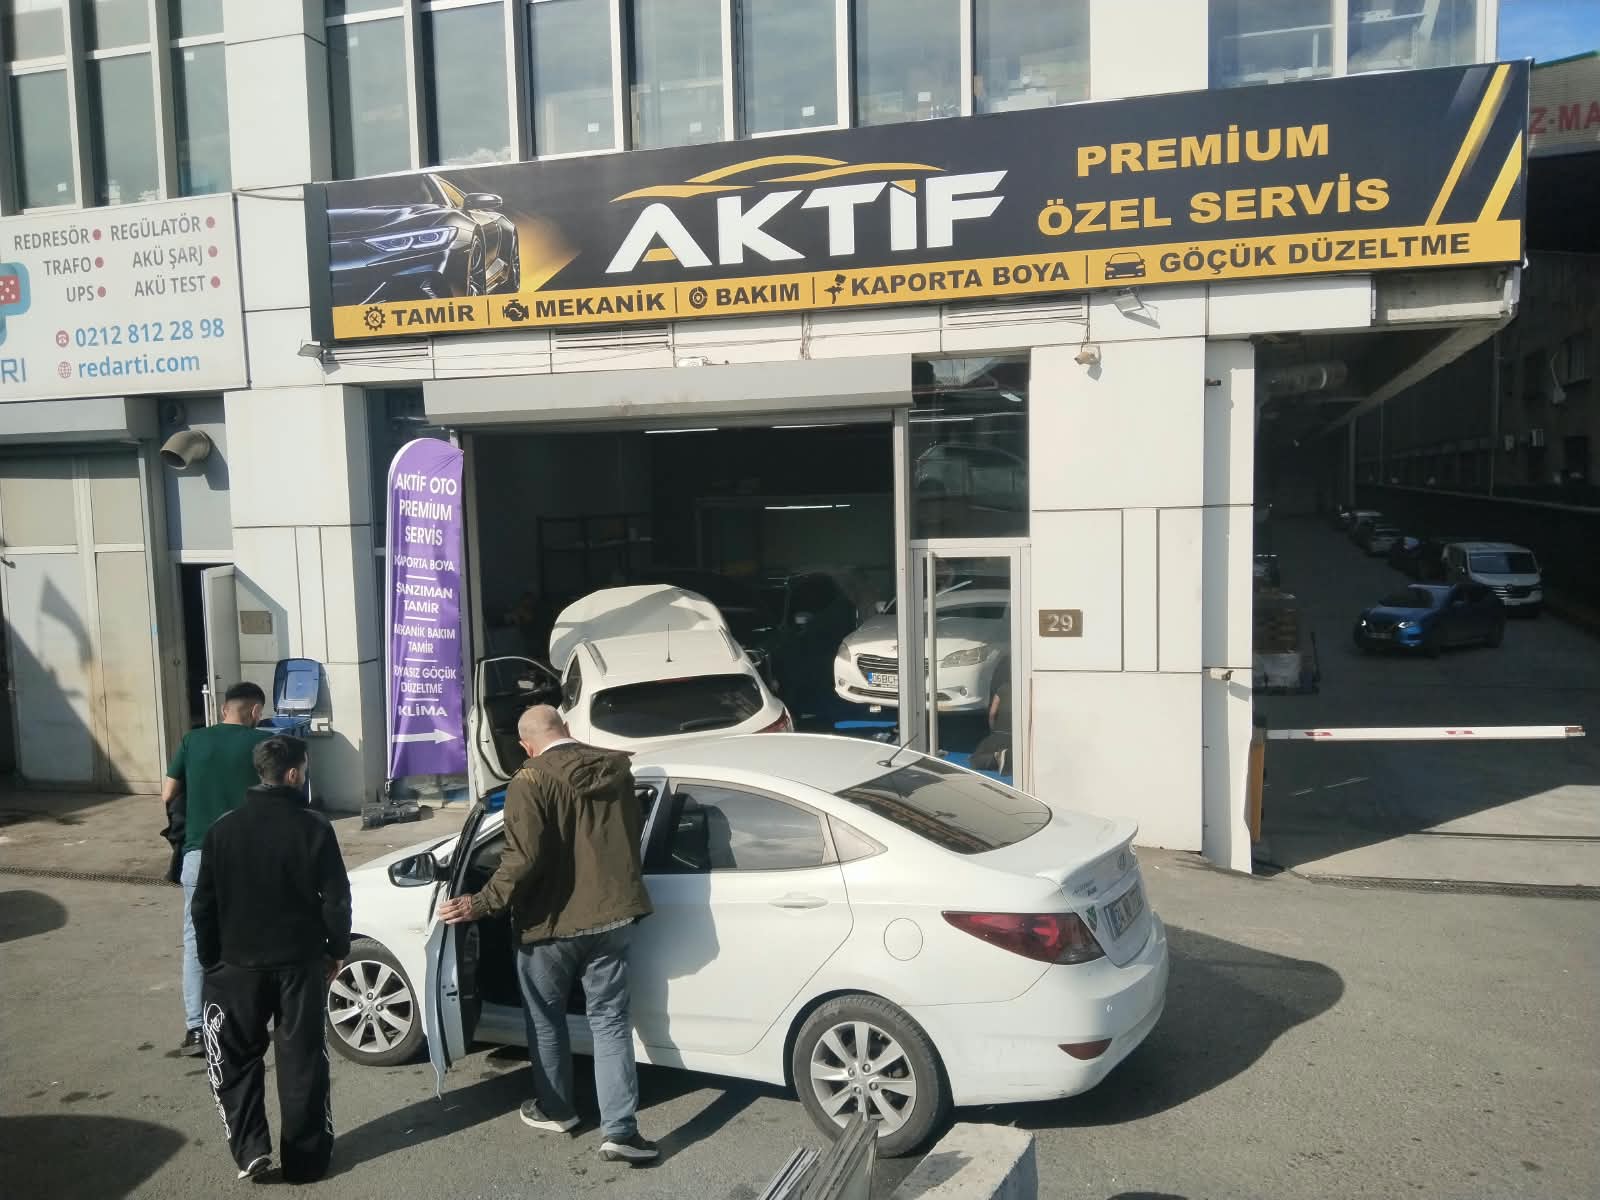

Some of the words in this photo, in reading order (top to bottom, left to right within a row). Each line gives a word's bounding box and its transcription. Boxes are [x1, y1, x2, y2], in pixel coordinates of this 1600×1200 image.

[1077, 123, 1330, 177] PREMİUM
[1038, 197, 1171, 236] ÖZEL
[1190, 173, 1390, 224] SERVİS
[110, 213, 201, 241] REGÜLATÖR
[604, 170, 1009, 274] AKTİF
[13, 225, 90, 250] REDRESÖR
[132, 248, 164, 269] AKÜ
[168, 245, 203, 270] ŞARJ
[1159, 243, 1276, 275] GÖÇÜK
[1288, 232, 1470, 264] DÜZELTME
[43, 256, 91, 276] TRAFO
[134, 277, 166, 297] AKÜ
[170, 275, 205, 293] TEST
[852, 268, 982, 297] KAPORTA
[992, 261, 1069, 287] BOYA
[66, 286, 94, 302] UPS
[536, 290, 665, 318] MEKANİK
[716, 283, 800, 306] BAKIM
[392, 302, 475, 327] TAMİR
[75, 325, 122, 347] 0212
[128, 322, 164, 344] 812
[170, 320, 194, 341] 28
[200, 318, 225, 338] 98
[78, 354, 200, 378] redarti.com
[395, 472, 426, 493] AKTİF
[430, 477, 457, 495] OTO
[400, 498, 452, 520] PREMİUM
[405, 524, 443, 545] SERVİS
[430, 559, 455, 572] BOYA
[404, 599, 439, 614] TAMİR
[428, 627, 456, 640] BAKIM
[1047, 613, 1073, 632] 29
[408, 640, 434, 654] TAMİR
[422, 665, 456, 682] GÖÇÜK
[401, 680, 443, 694] DÜZELTME
[398, 704, 448, 717] KLİMA
